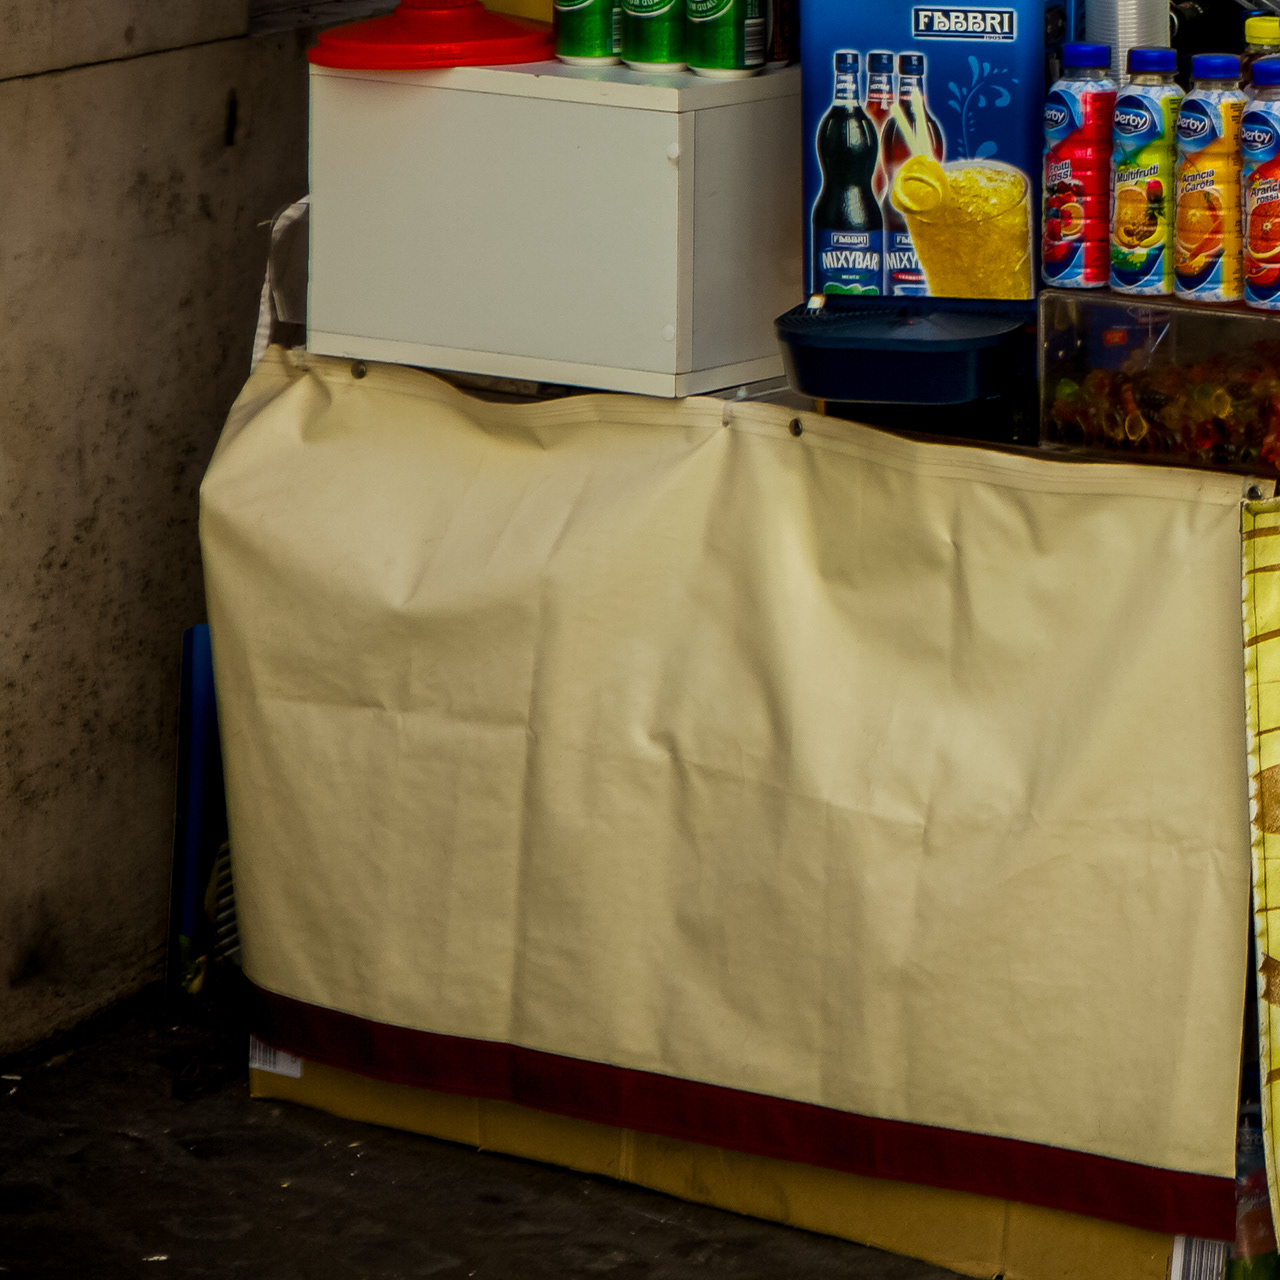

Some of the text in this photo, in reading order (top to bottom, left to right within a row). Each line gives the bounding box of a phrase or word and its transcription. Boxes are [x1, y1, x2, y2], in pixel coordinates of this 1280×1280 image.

[918, 11, 1010, 34] FABBRI
[1045, 108, 1065, 123] erby
[1114, 112, 1146, 127] Derby
[1241, 126, 1271, 143] Derby
[1116, 164, 1159, 183] Multifrutti
[1182, 169, 1215, 184] Arancia
[1185, 179, 1215, 194] Carota
[1256, 192, 1280, 205] rossa
[822, 250, 881, 271] MIXYBAR
